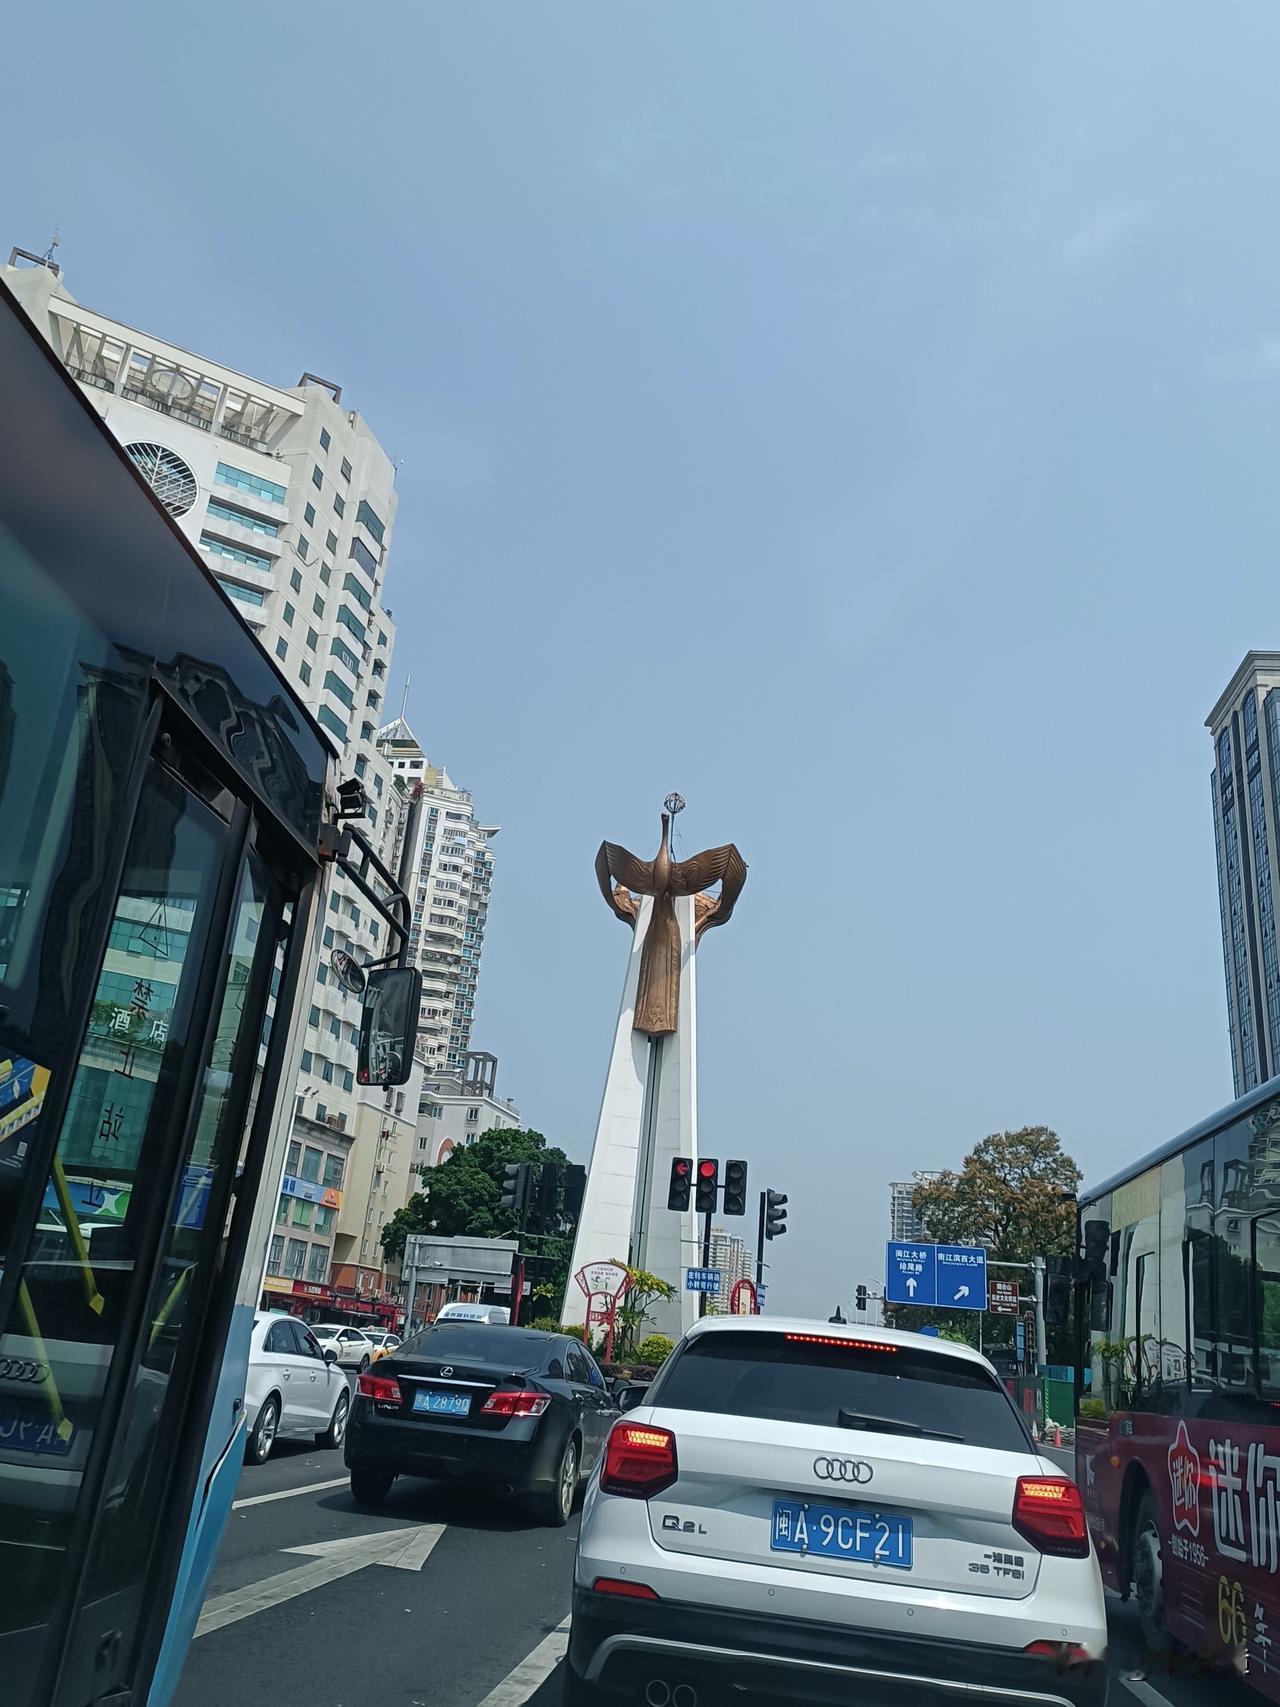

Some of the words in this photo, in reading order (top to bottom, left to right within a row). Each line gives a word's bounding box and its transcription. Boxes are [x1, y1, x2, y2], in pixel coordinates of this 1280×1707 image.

[109, 1008, 168, 1045] 酒店
[895, 1249, 927, 1260] 闽江大桥
[938, 1252, 984, 1264] 南江滨西大道
[662, 1514, 708, 1535] Q2L
[968, 1562, 990, 1575] 35
[993, 1565, 1025, 1581] TFSI
